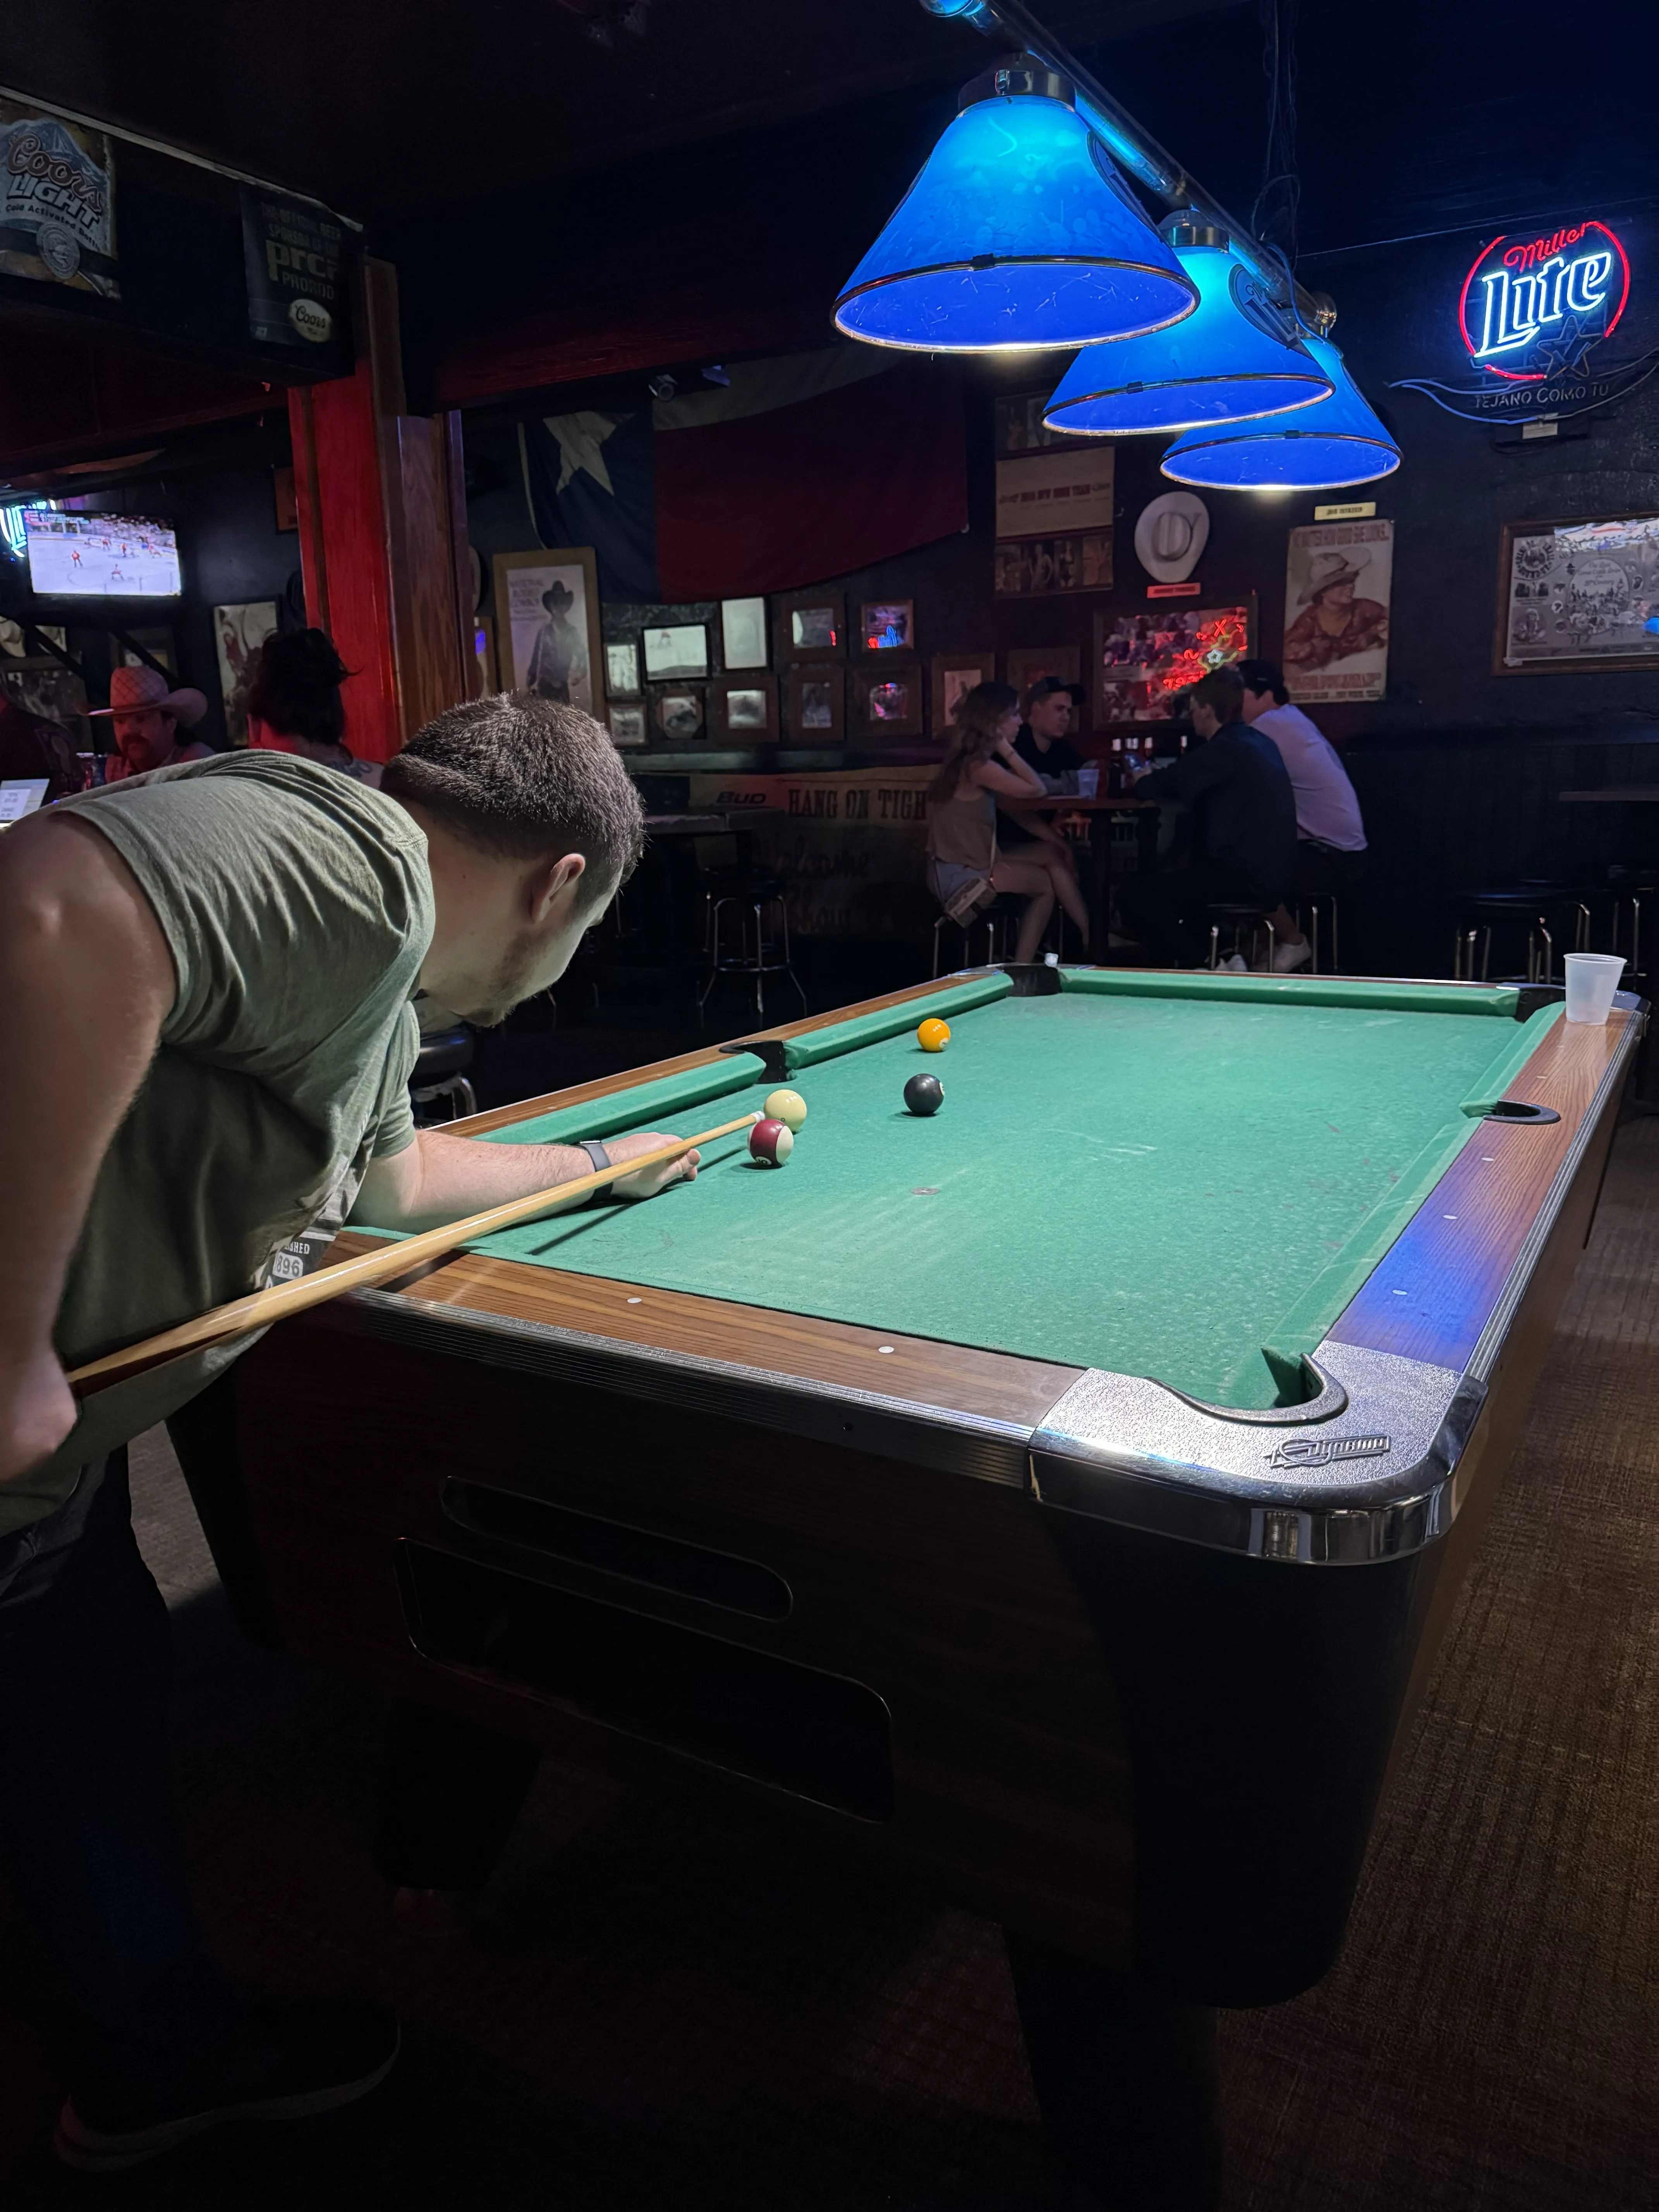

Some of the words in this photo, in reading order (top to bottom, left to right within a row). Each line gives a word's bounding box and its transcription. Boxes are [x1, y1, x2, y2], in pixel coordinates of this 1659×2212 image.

[8, 133, 102, 214] Coors
[6, 204, 24, 213] Cold
[7, 174, 100, 229] LIGHT
[1503, 222, 1586, 272] Miller
[295, 304, 326, 328] Coors
[1474, 252, 1611, 358] Lite
[1475, 390, 1531, 409] TEJANO
[1537, 386, 1586, 403] COMO
[1590, 381, 1609, 396] TU
[788, 789, 838, 819] HANG
[846, 790, 870, 819] ON
[878, 789, 929, 820] TIGH
[285, 1242, 310, 1254] SHED
